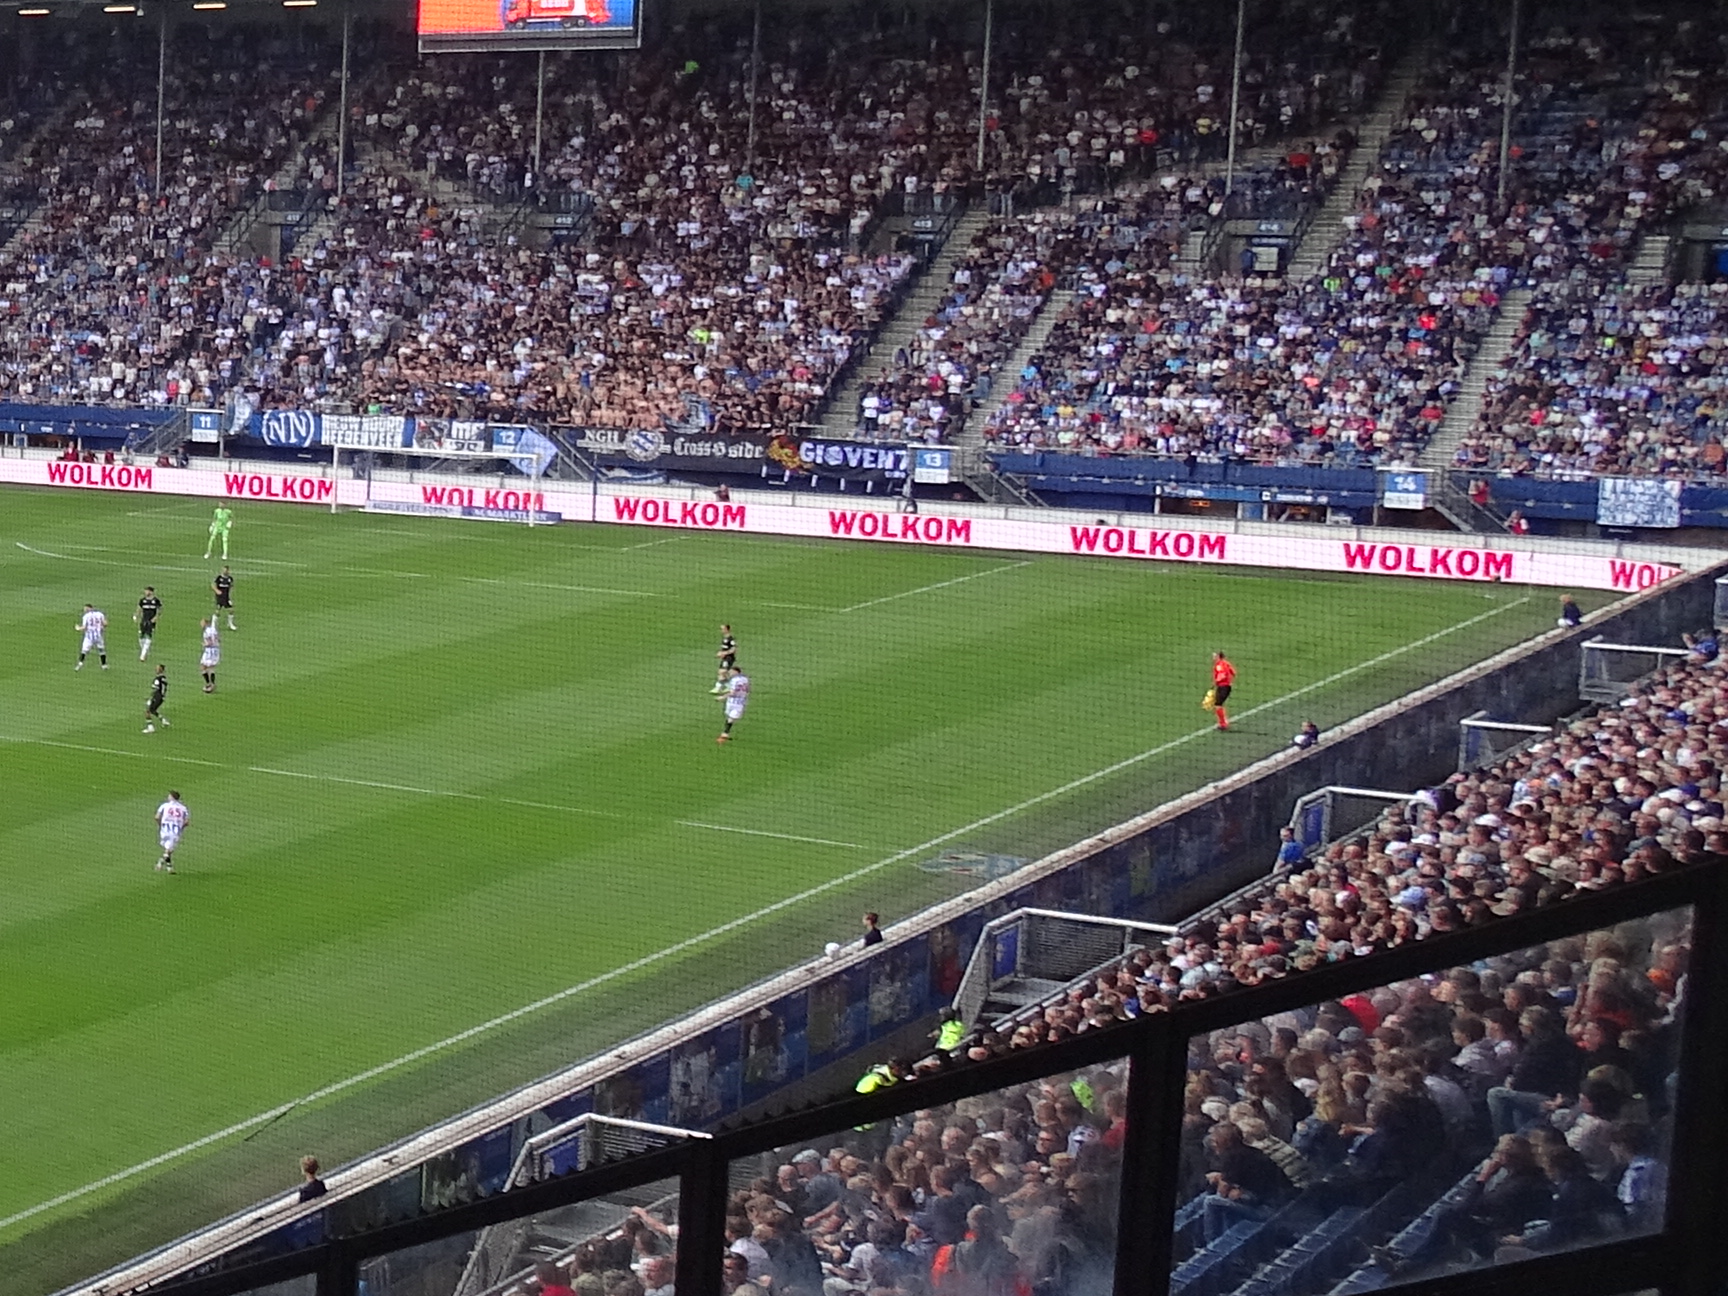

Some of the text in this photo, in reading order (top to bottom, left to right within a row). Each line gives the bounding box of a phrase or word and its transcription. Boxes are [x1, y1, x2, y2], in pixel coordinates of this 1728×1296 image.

[199, 417, 211, 428] 11
[500, 432, 515, 444] 12
[923, 453, 942, 466] 13
[47, 461, 152, 490] WOLKOM
[224, 472, 333, 501] WOLKOM
[613, 497, 746, 528] WOLKOM
[828, 510, 972, 544] WOLKOM
[1069, 526, 1226, 560] WOLKOM
[1343, 542, 1513, 579] WOLKOM
